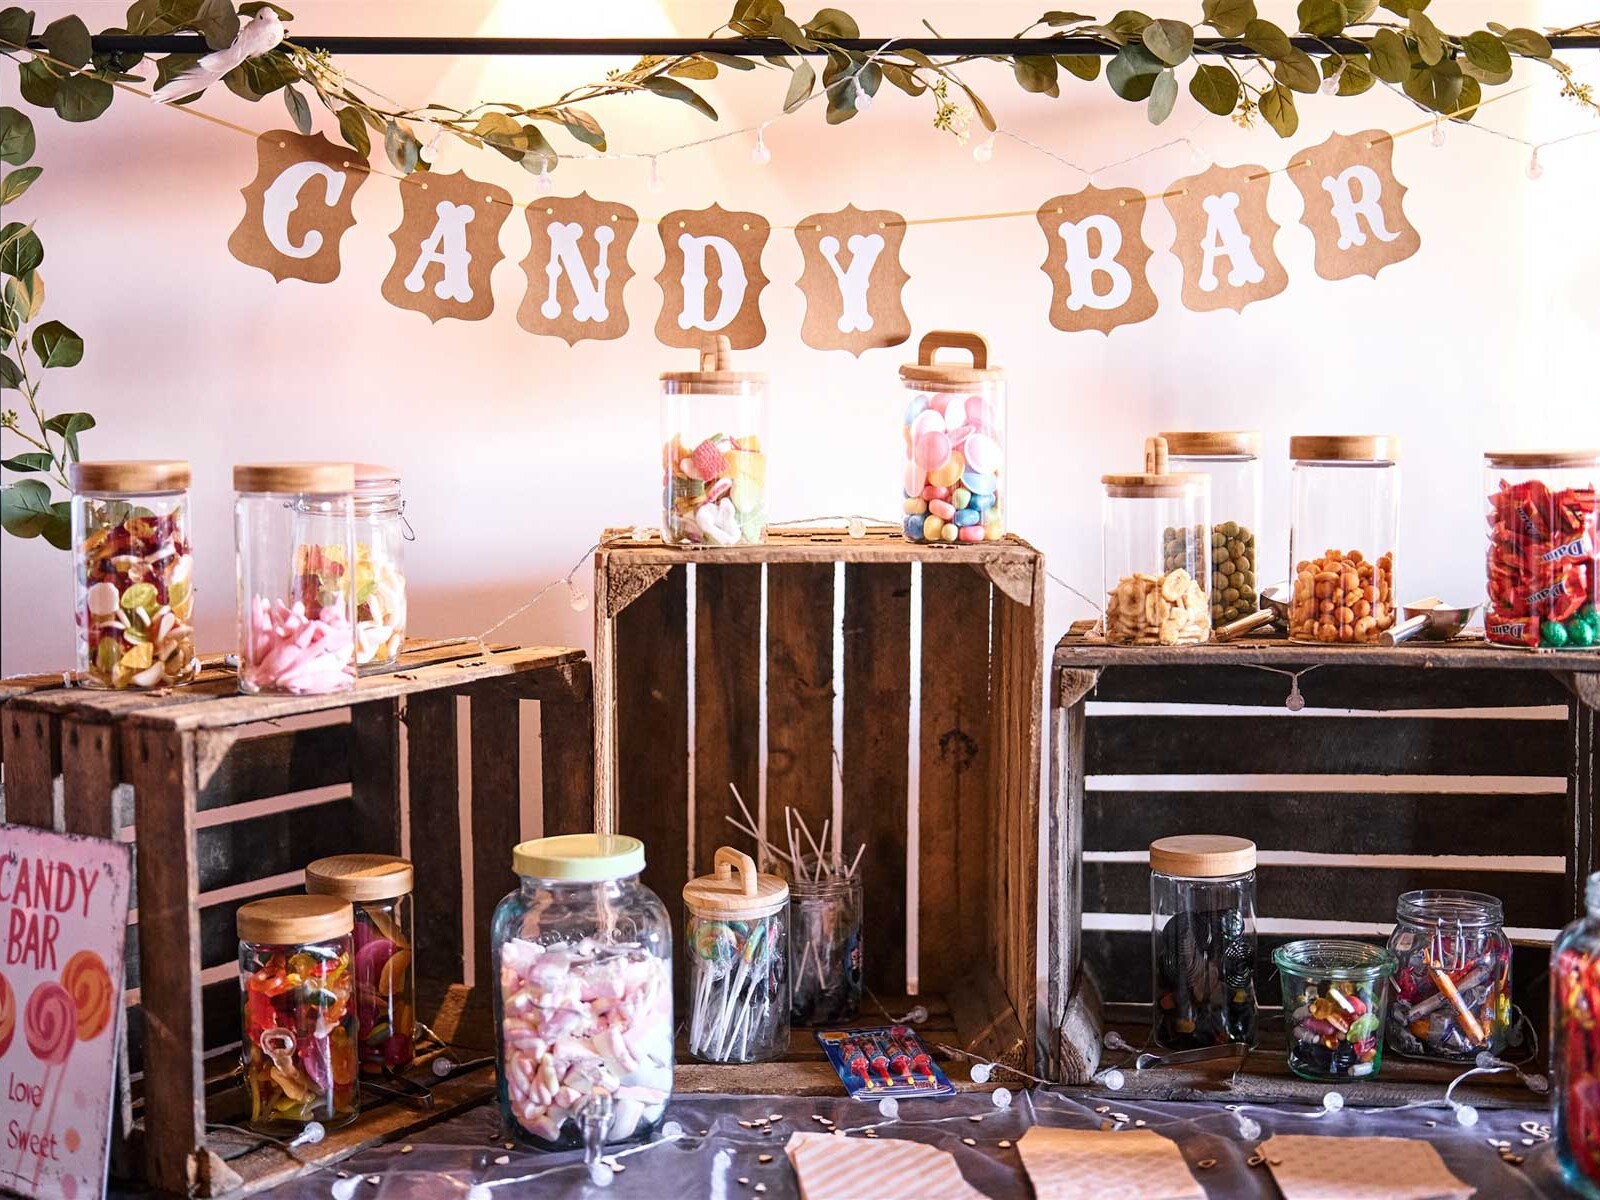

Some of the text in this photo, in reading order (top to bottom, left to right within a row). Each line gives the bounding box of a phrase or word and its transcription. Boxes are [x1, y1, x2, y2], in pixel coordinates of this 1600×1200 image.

[262, 161, 1401, 333] CANDY BAR
[1541, 538, 1584, 563] Daim
[0, 853, 99, 917] CANDY
[6, 907, 60, 971] BAR
[8, 1072, 43, 1107] Love
[7, 1119, 60, 1161] Sweet
